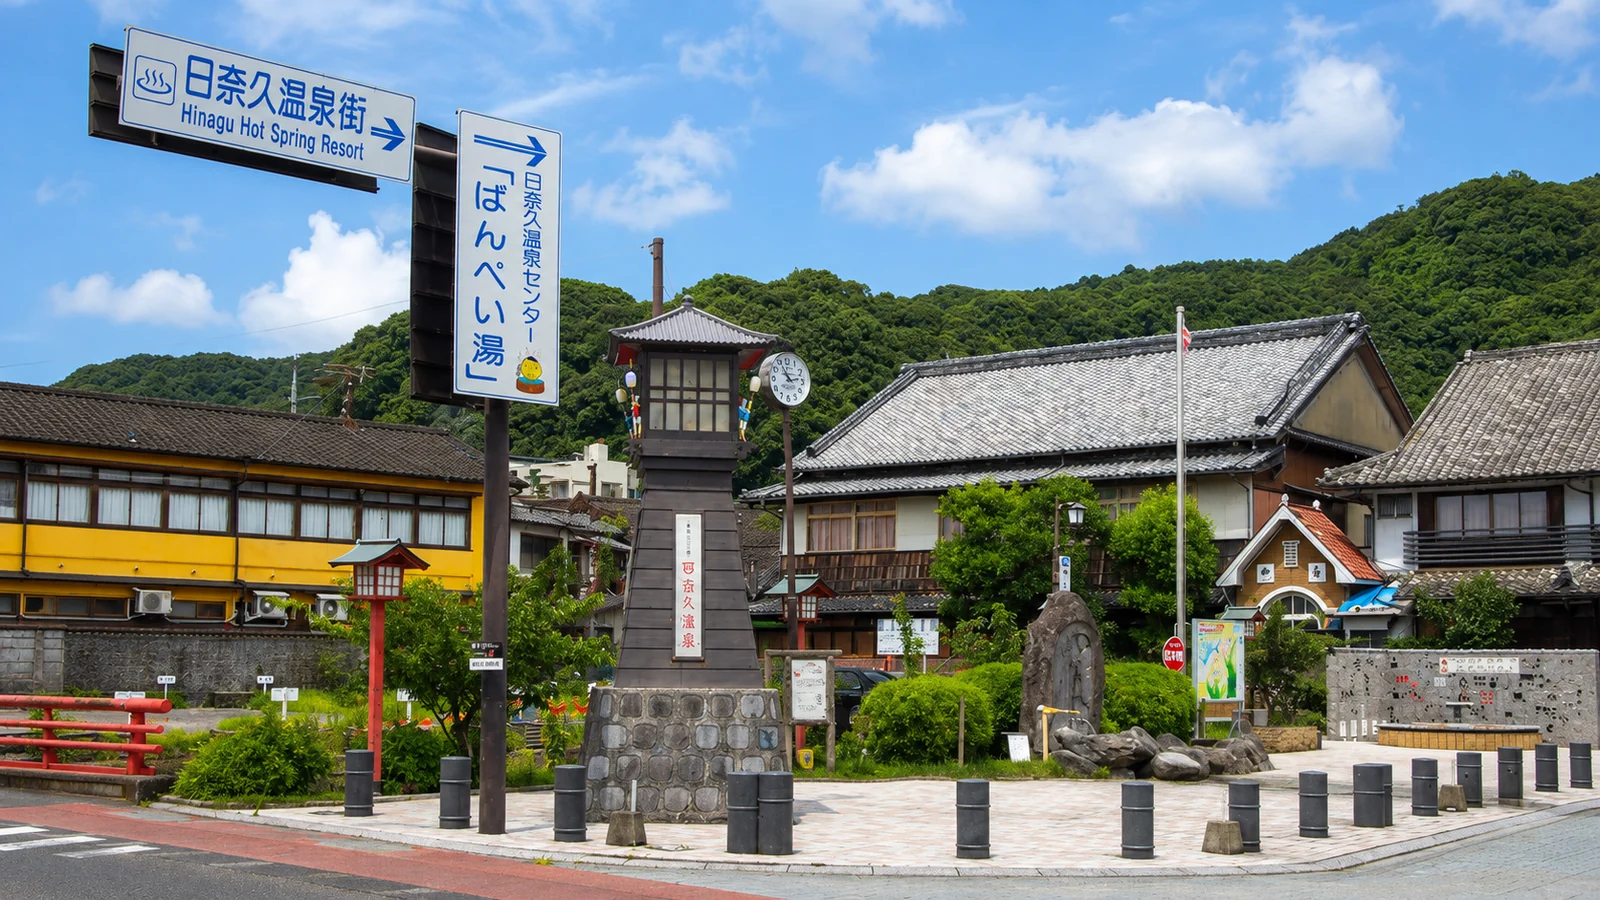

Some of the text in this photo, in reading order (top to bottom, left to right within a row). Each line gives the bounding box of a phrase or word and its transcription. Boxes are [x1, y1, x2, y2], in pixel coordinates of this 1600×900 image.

[181, 102, 364, 161] Hinagu Hot Spring Resort
[185, 54, 367, 134] 日奈久温泉街
[465, 165, 515, 382] 「ばんぺい湯」
[522, 171, 542, 343] 日奈久温泉センター
